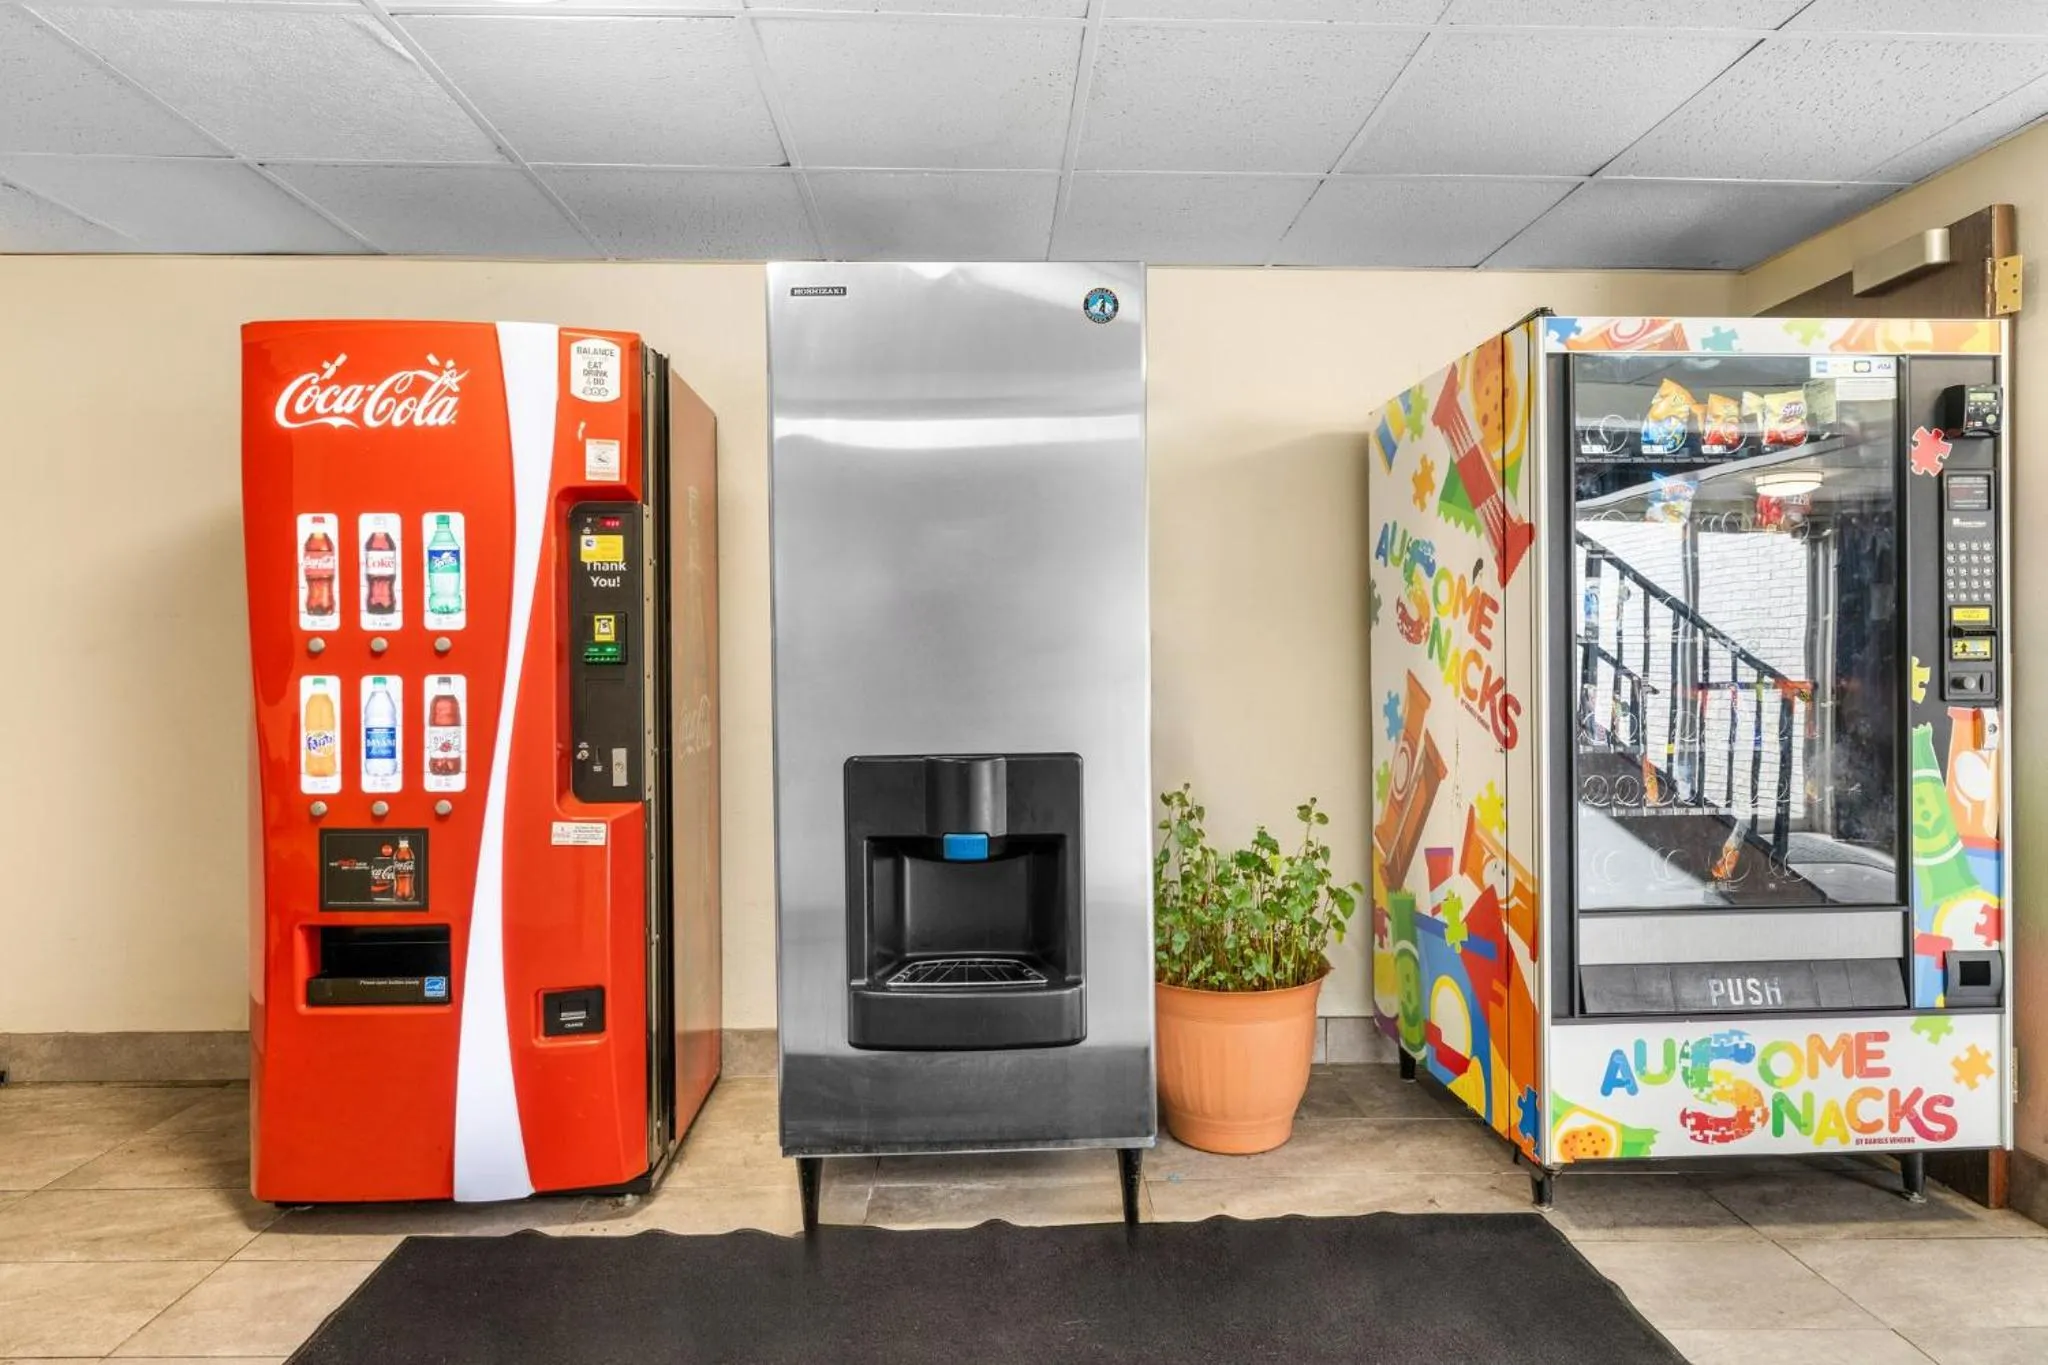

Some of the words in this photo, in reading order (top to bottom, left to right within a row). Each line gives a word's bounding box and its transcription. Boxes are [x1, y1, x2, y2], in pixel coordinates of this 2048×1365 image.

[274, 362, 468, 430] Coca-Cola
[585, 561, 627, 571] Thank
[590, 576, 620, 587] You!
[1708, 976, 1783, 1007] PUSH
